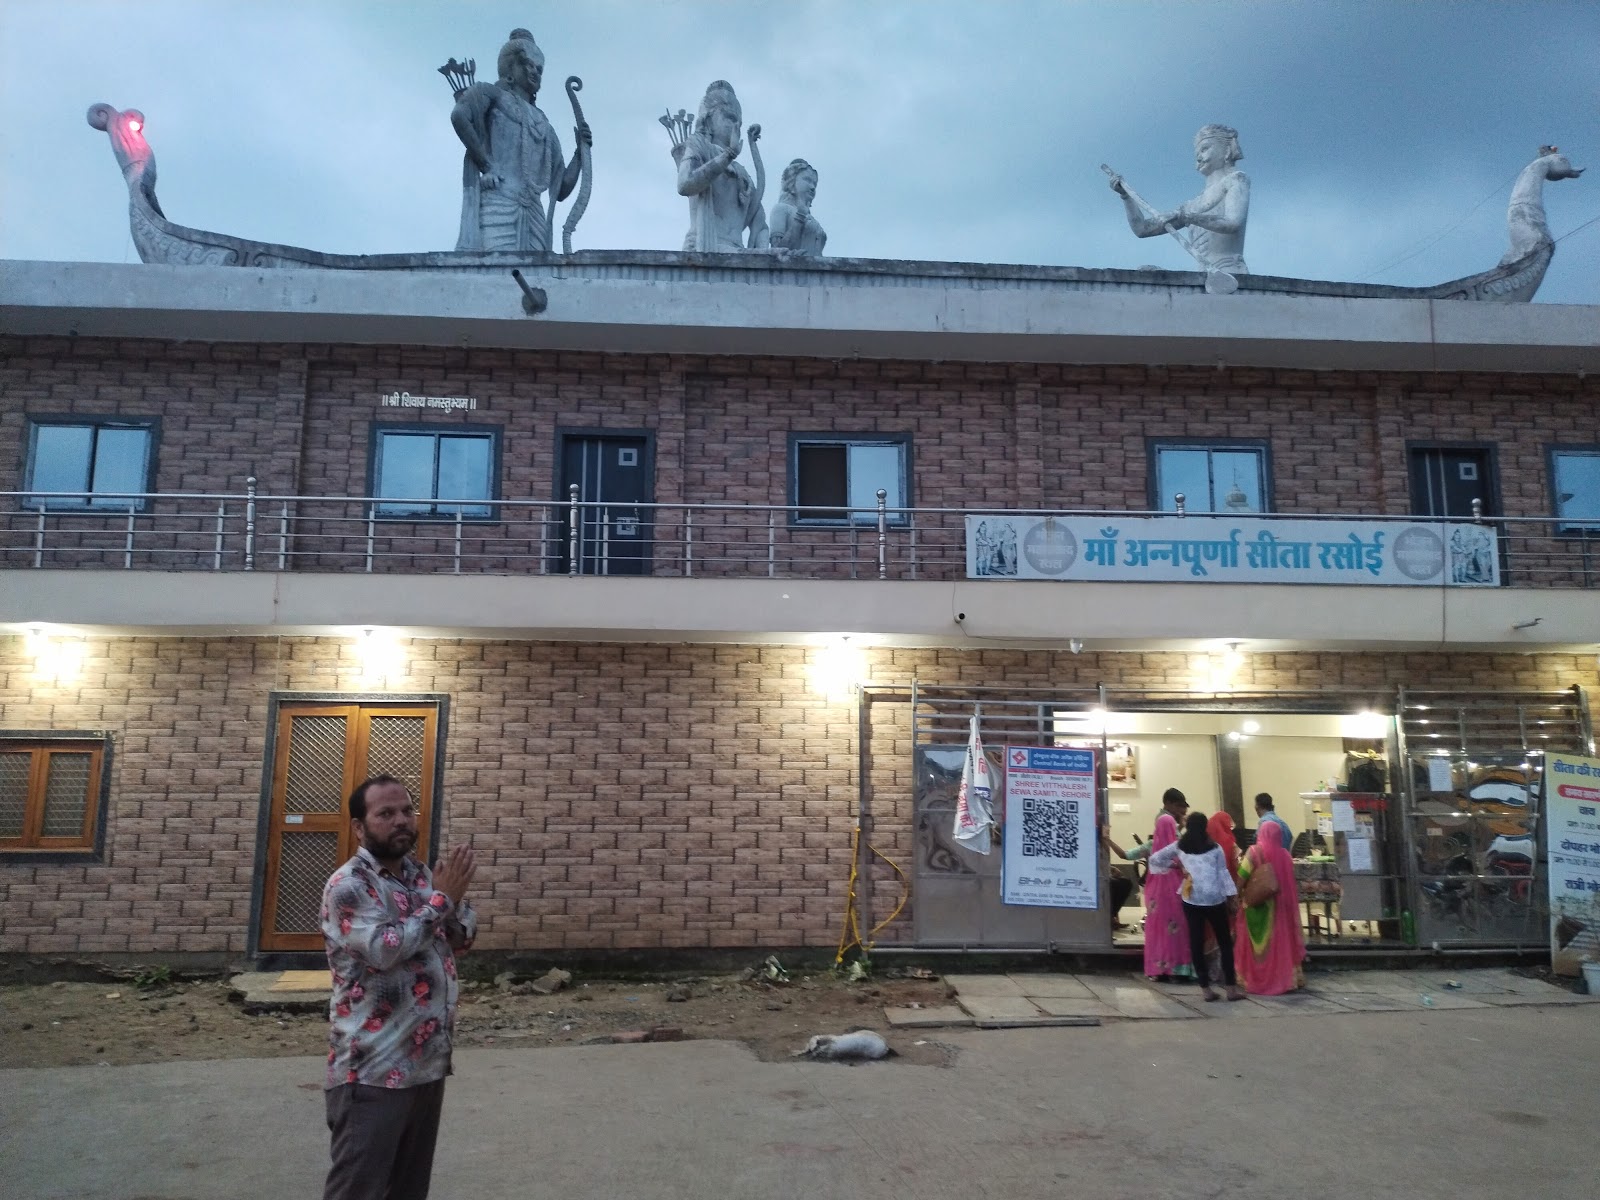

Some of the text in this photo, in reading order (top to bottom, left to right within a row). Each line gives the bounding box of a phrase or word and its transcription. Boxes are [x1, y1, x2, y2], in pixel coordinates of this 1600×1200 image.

[401, 391, 426, 408] शिवाय
[1083, 526, 1385, 577] माँ अन्नपूर्णा सीता रसोई
[1552, 759, 1575, 774] सीता
[1575, 763, 1591, 776] की
[1015, 780, 1087, 790] SHREE VITTHALESH
[1010, 788, 1032, 796] SEWA
[1061, 790, 1092, 799] SEHORE
[1560, 839, 1588, 853] दोपहर
